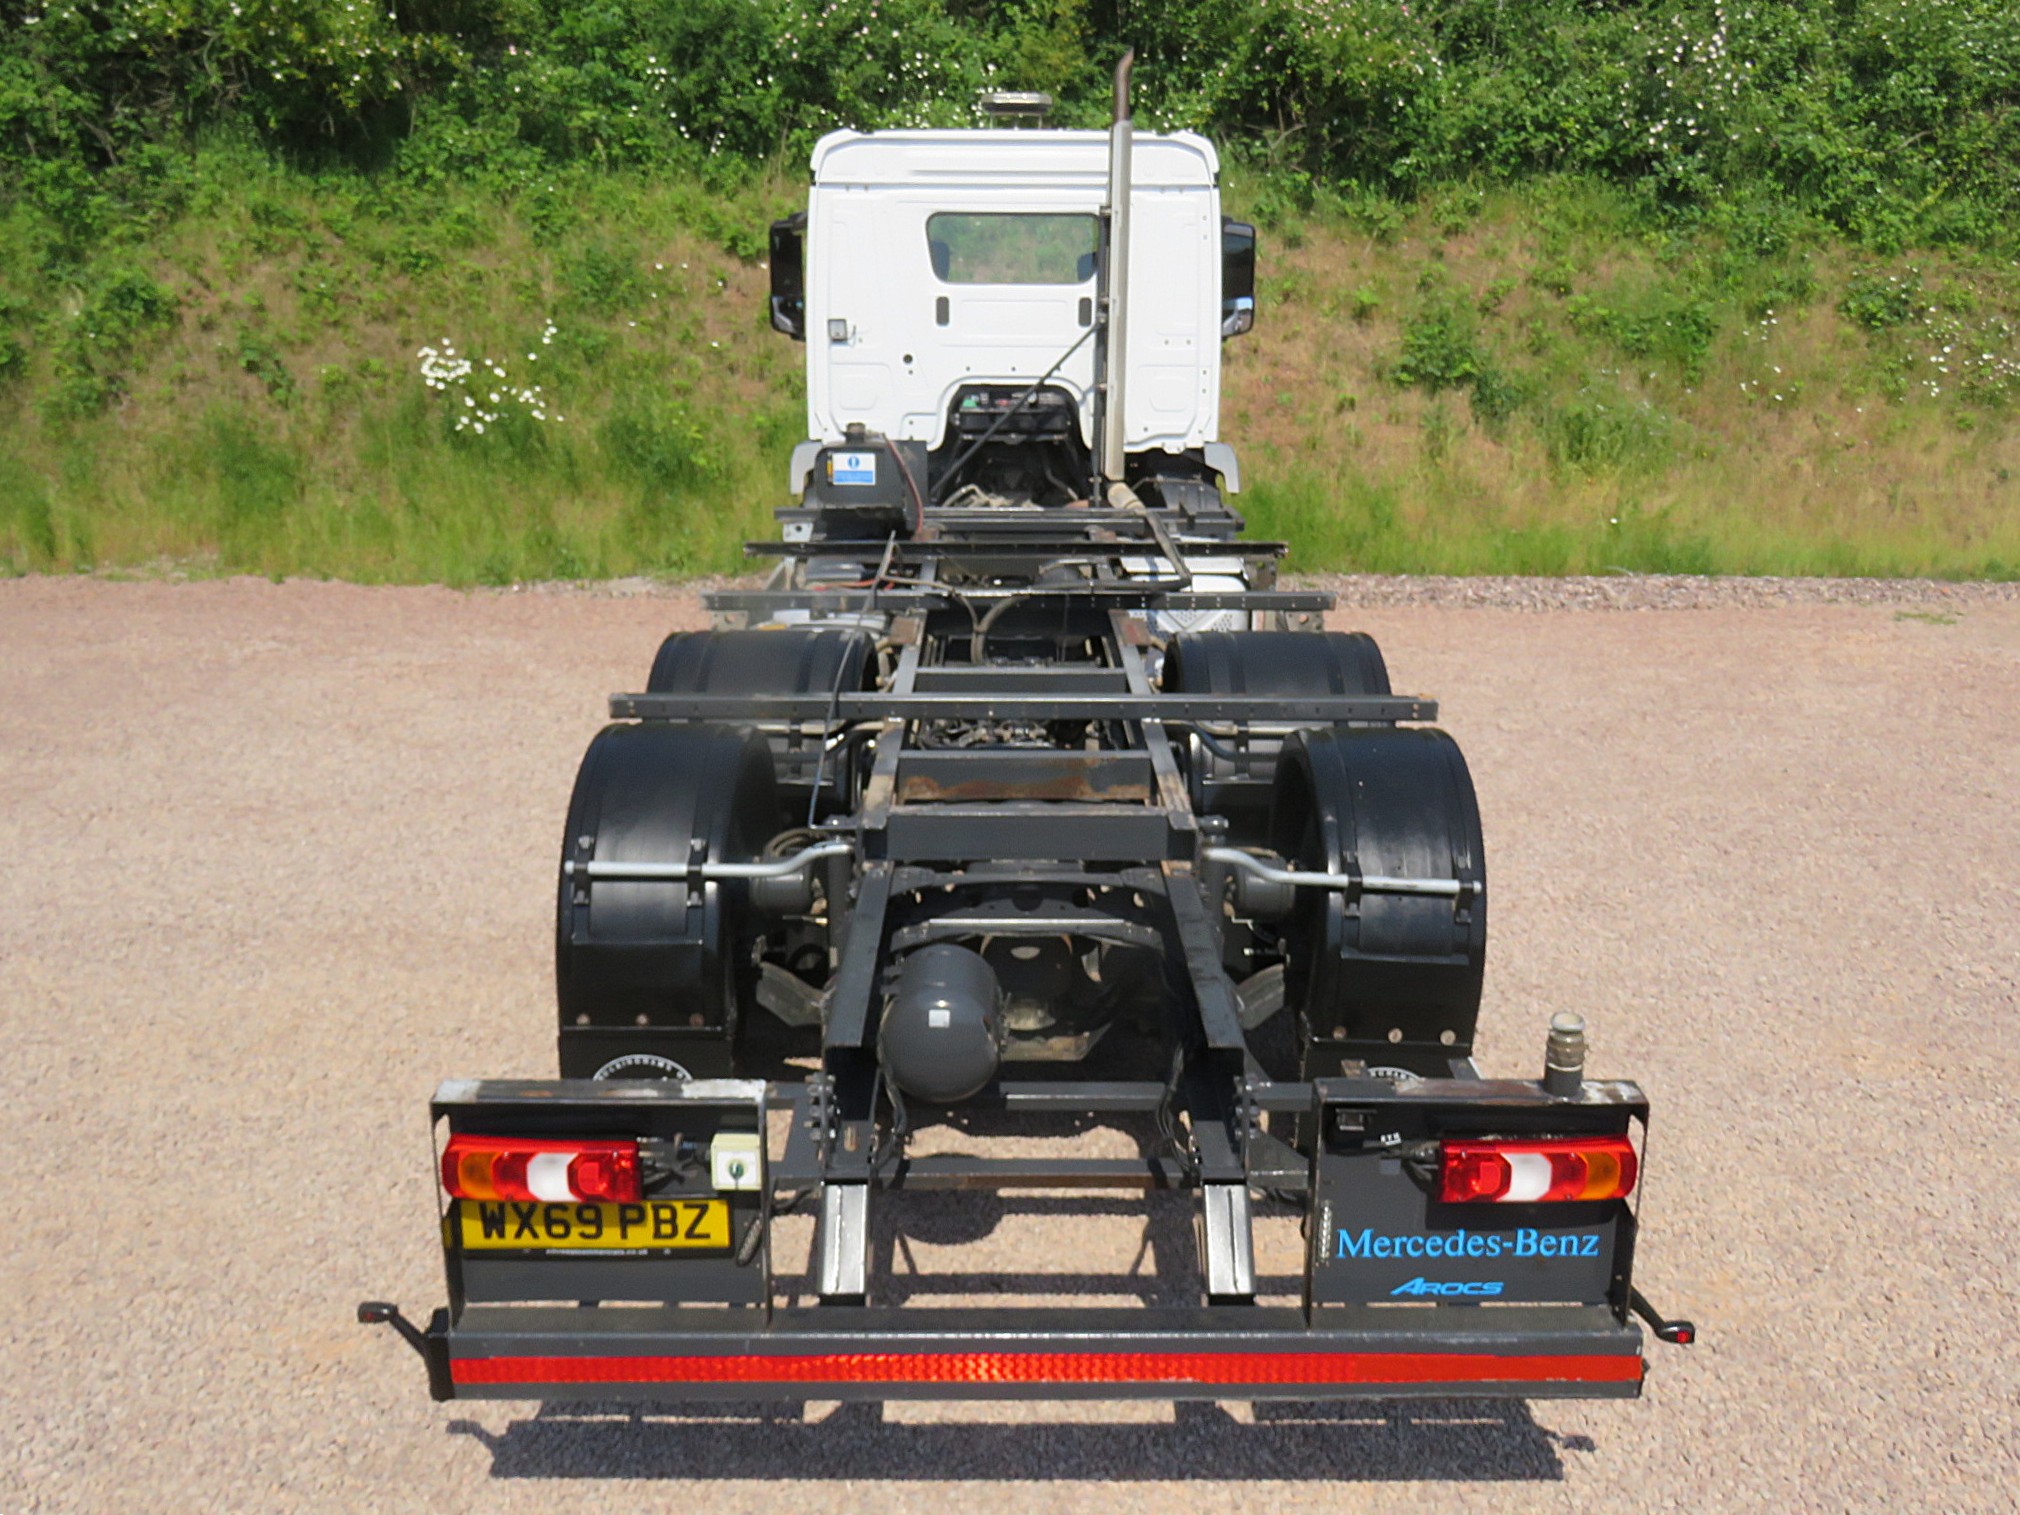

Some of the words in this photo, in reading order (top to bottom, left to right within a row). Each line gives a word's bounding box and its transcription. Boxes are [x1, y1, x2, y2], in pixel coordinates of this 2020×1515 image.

[478, 1202, 603, 1240] WX69
[618, 1202, 711, 1240] PBZ
[1335, 1228, 1600, 1259] Mercedes-Benz
[1390, 1276, 1504, 1296] AROCS
